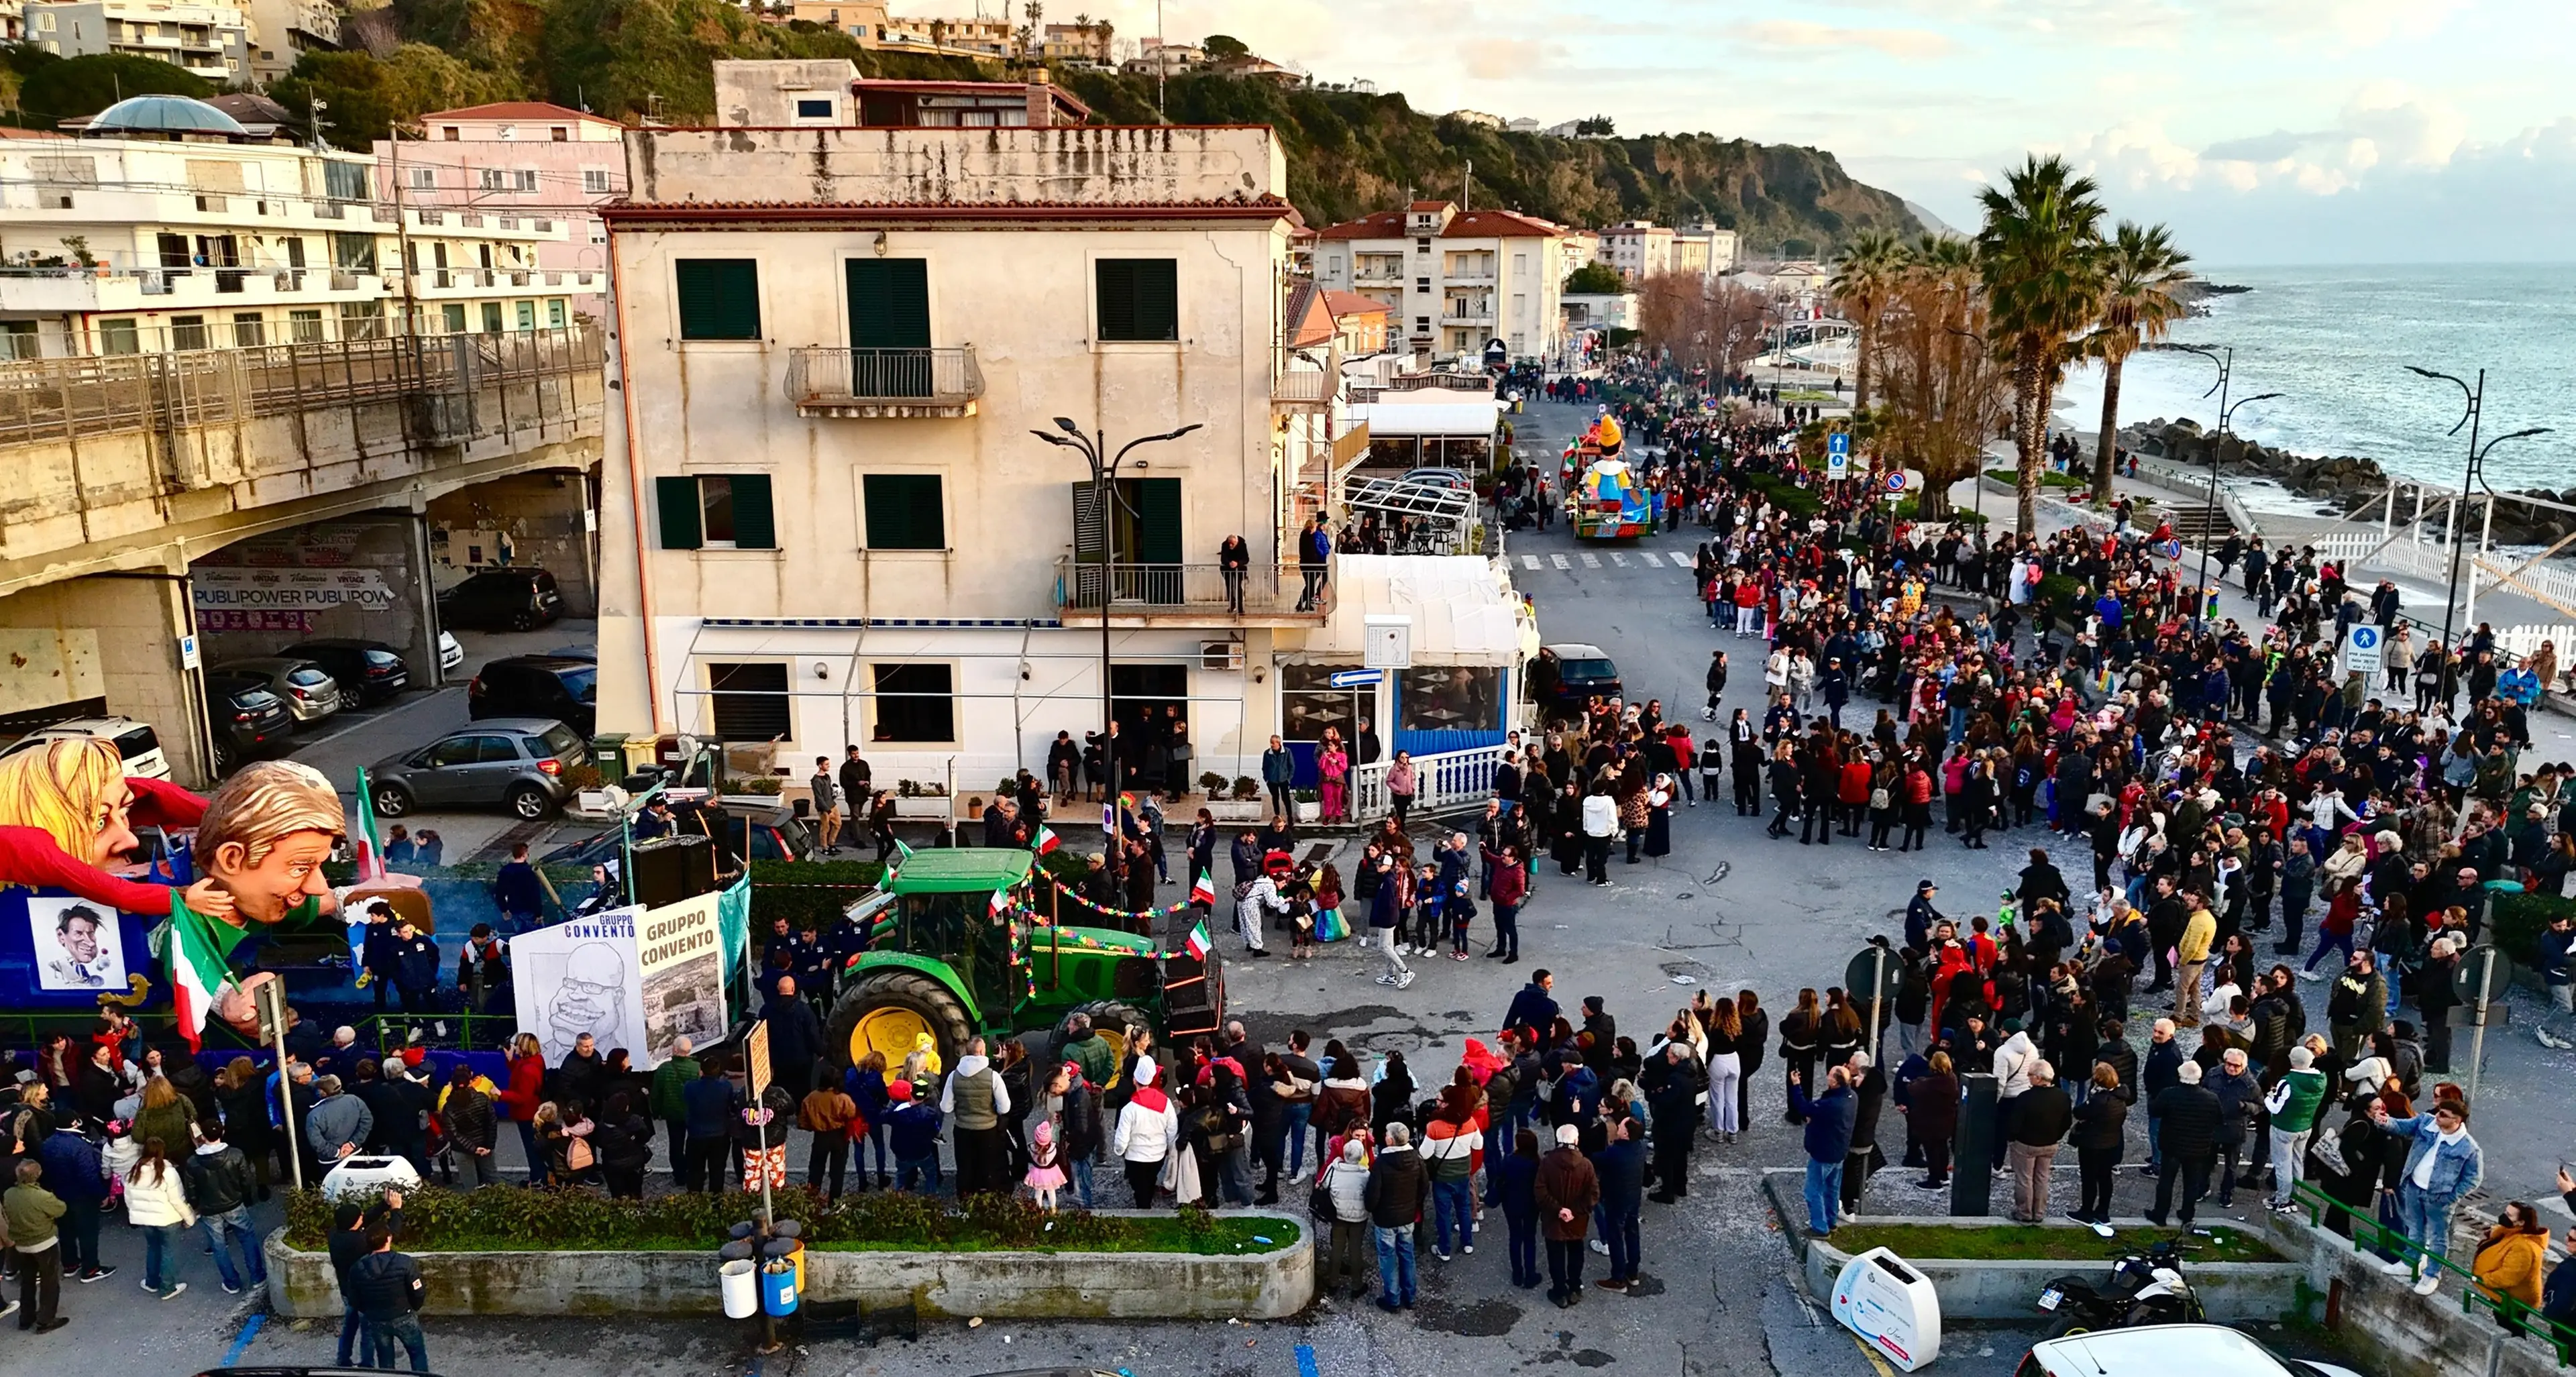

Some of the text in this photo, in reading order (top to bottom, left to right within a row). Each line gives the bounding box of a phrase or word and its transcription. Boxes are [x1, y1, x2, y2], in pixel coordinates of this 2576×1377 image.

[194, 590, 302, 604] PUBLIPOWER
[599, 915, 633, 926] GRUPPO
[647, 910, 706, 941] GRUPPO
[564, 925, 636, 938] CONVENTO
[641, 929, 714, 967] CONVENTO
